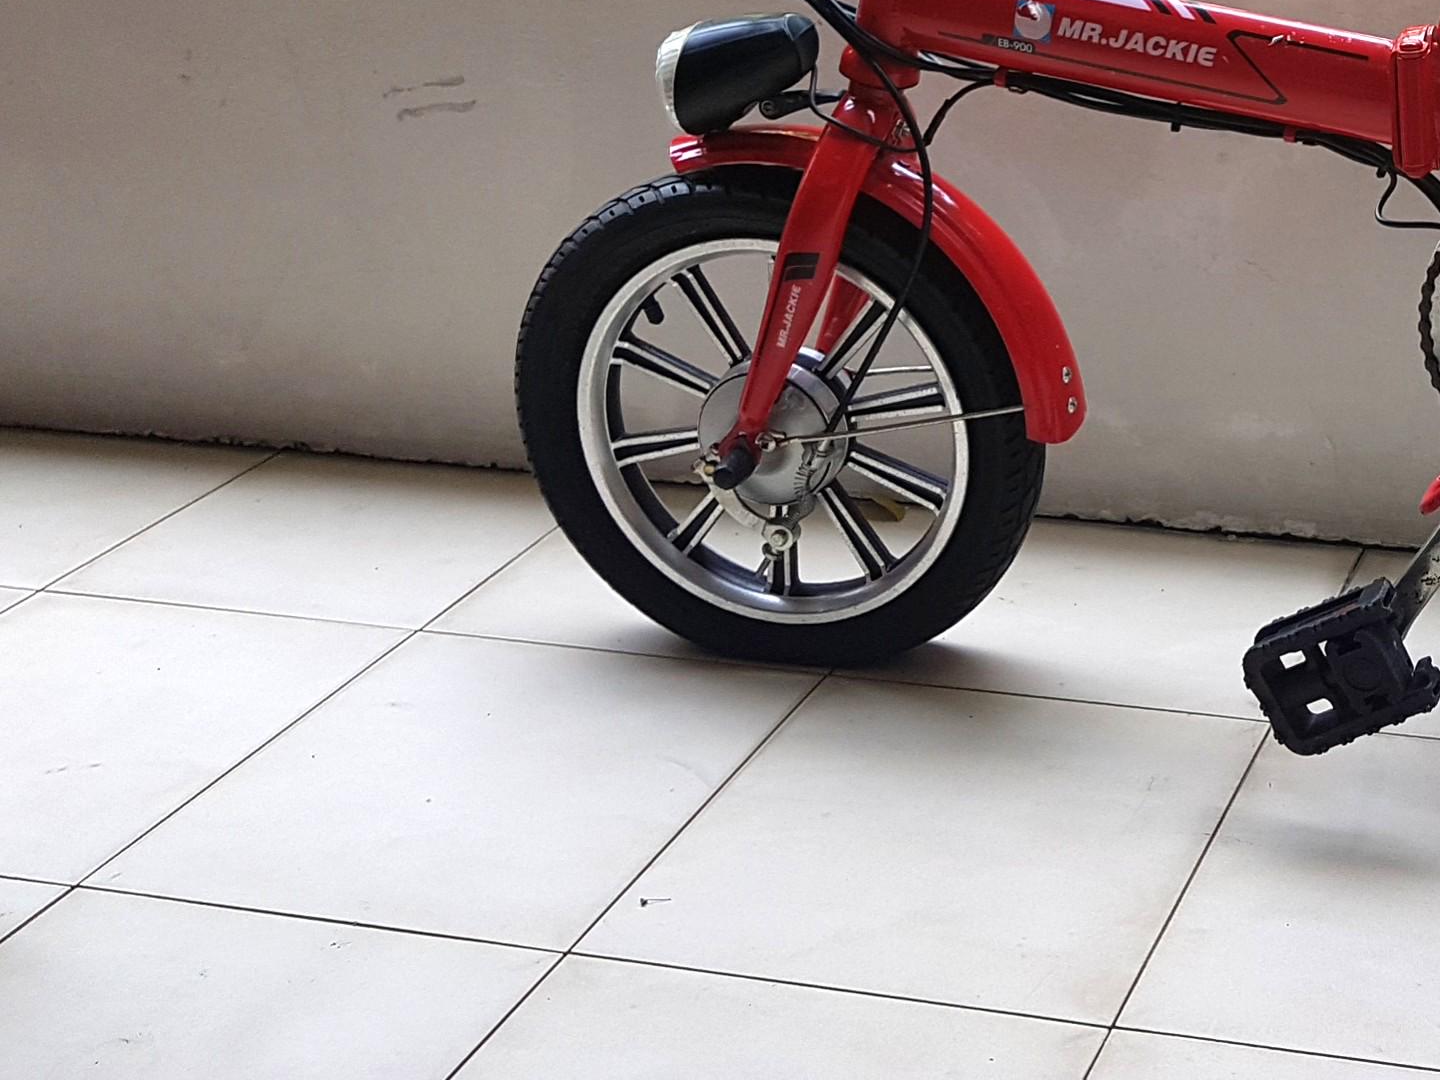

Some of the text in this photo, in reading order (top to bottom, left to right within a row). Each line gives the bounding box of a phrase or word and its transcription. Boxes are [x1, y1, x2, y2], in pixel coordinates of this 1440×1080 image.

[998, 38, 1033, 53] EB-900
[1057, 16, 1217, 67] MR.JACKIE
[776, 284, 802, 349] MR.JACKIE
